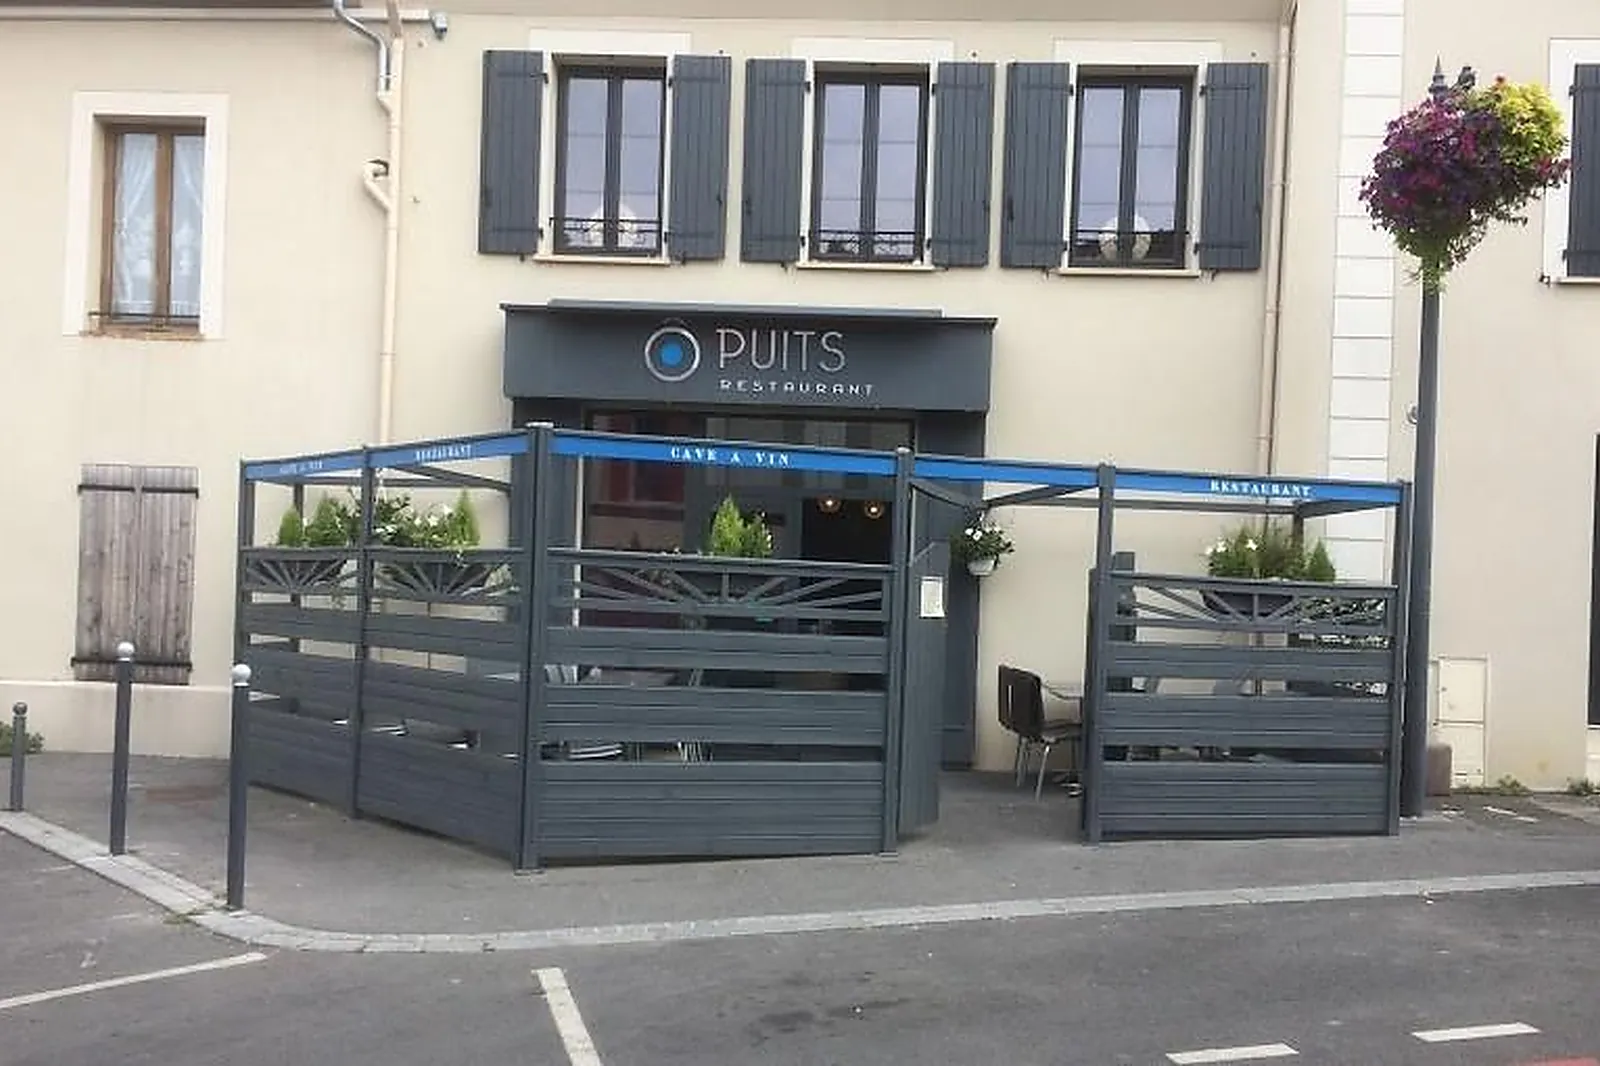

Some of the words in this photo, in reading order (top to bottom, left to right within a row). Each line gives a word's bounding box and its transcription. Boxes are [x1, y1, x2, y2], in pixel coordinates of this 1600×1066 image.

[716, 328, 846, 372] PUITS
[719, 379, 874, 396] RESTAURANT
[756, 452, 789, 465] VIN
[1209, 480, 1311, 497] RESTAURANT
